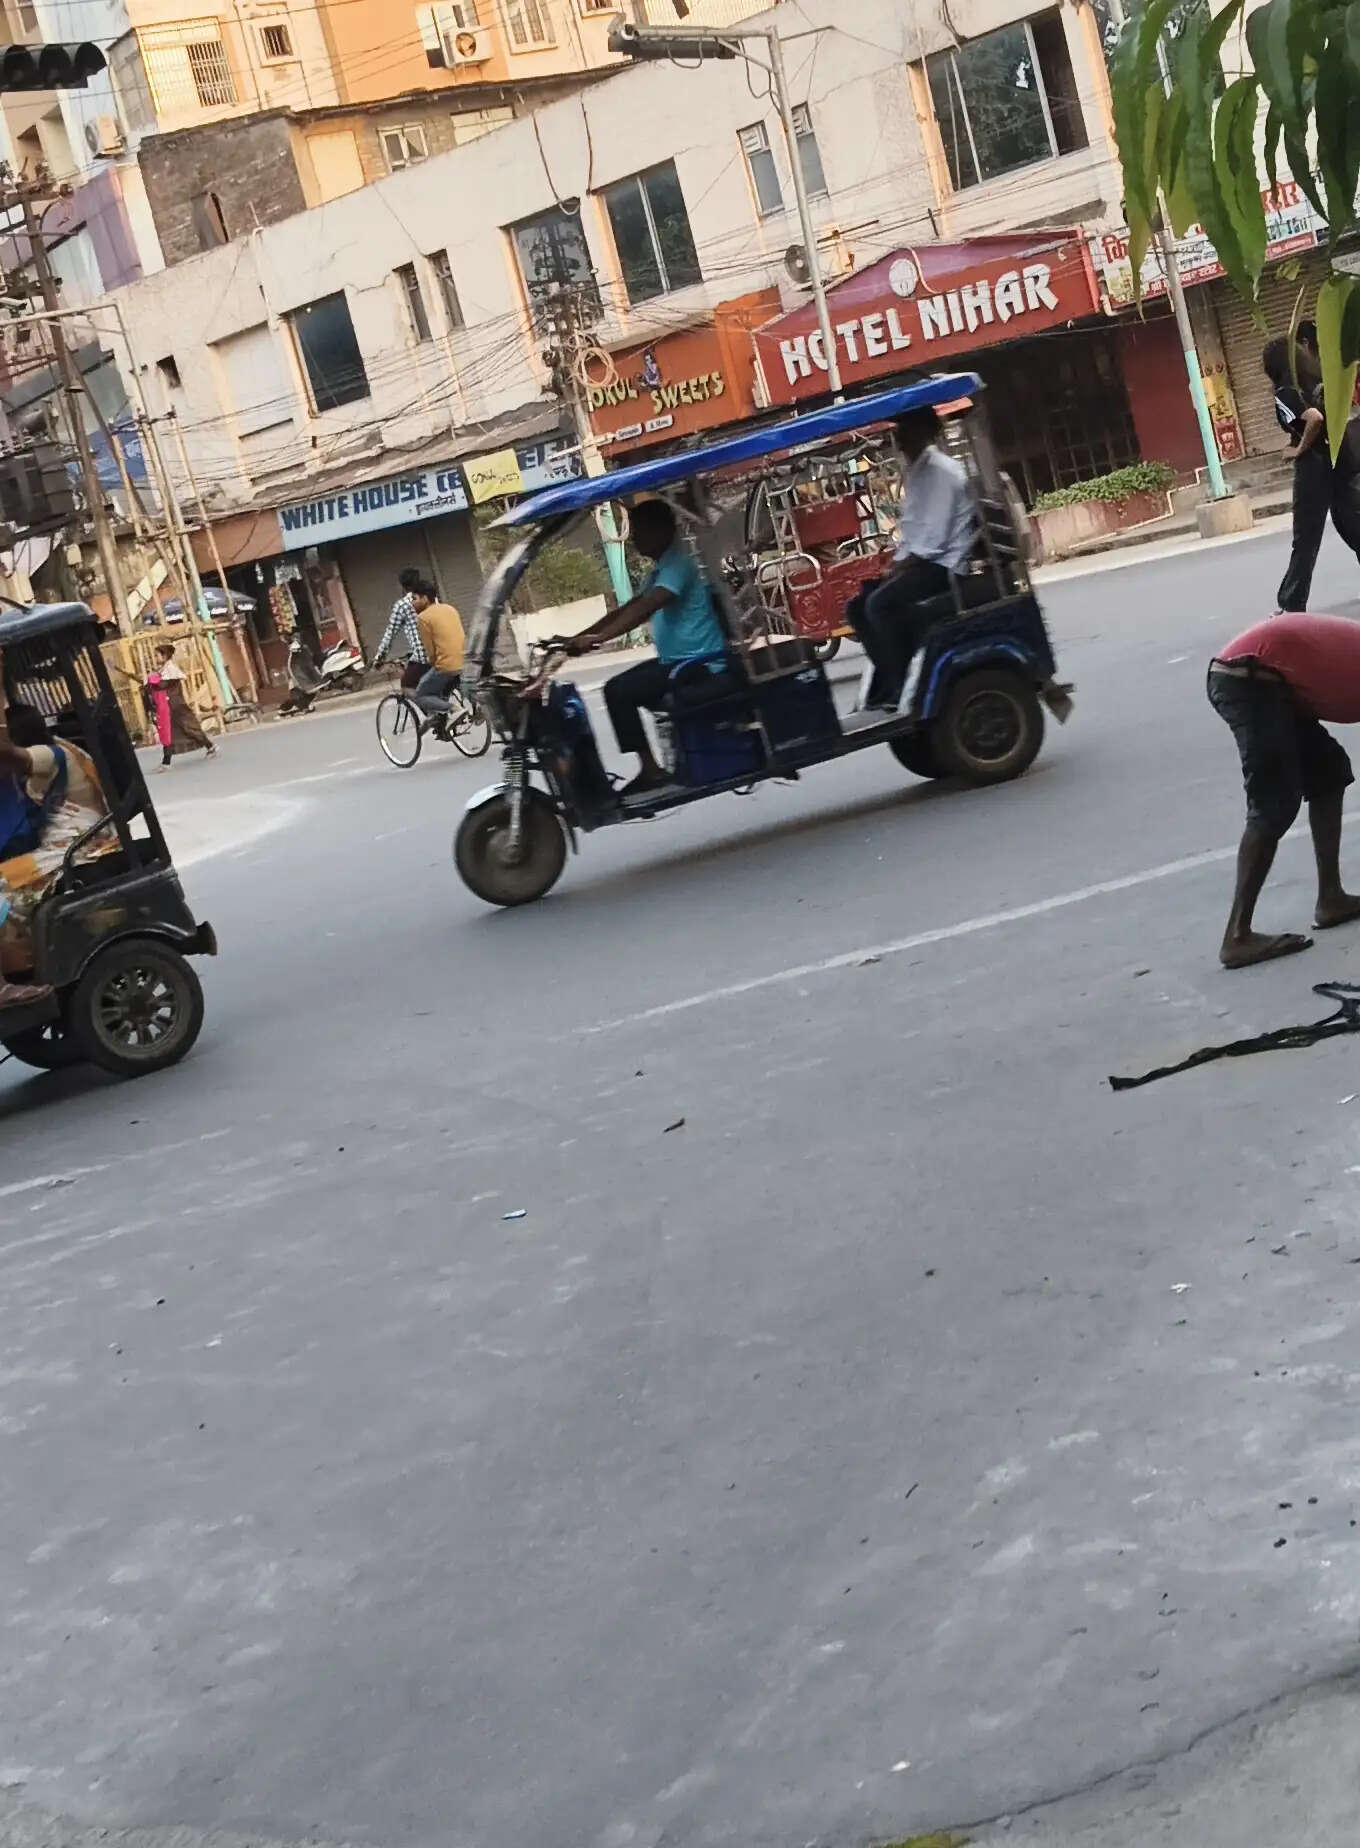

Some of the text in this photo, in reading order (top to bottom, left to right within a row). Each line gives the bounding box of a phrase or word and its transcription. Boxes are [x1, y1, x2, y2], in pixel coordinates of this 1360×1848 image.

[780, 263, 1060, 386] HOTEL NIHAR
[590, 377, 639, 409] OKUL
[650, 371, 726, 415] SWEETS
[281, 471, 463, 531] WHITE HOUSE CE
